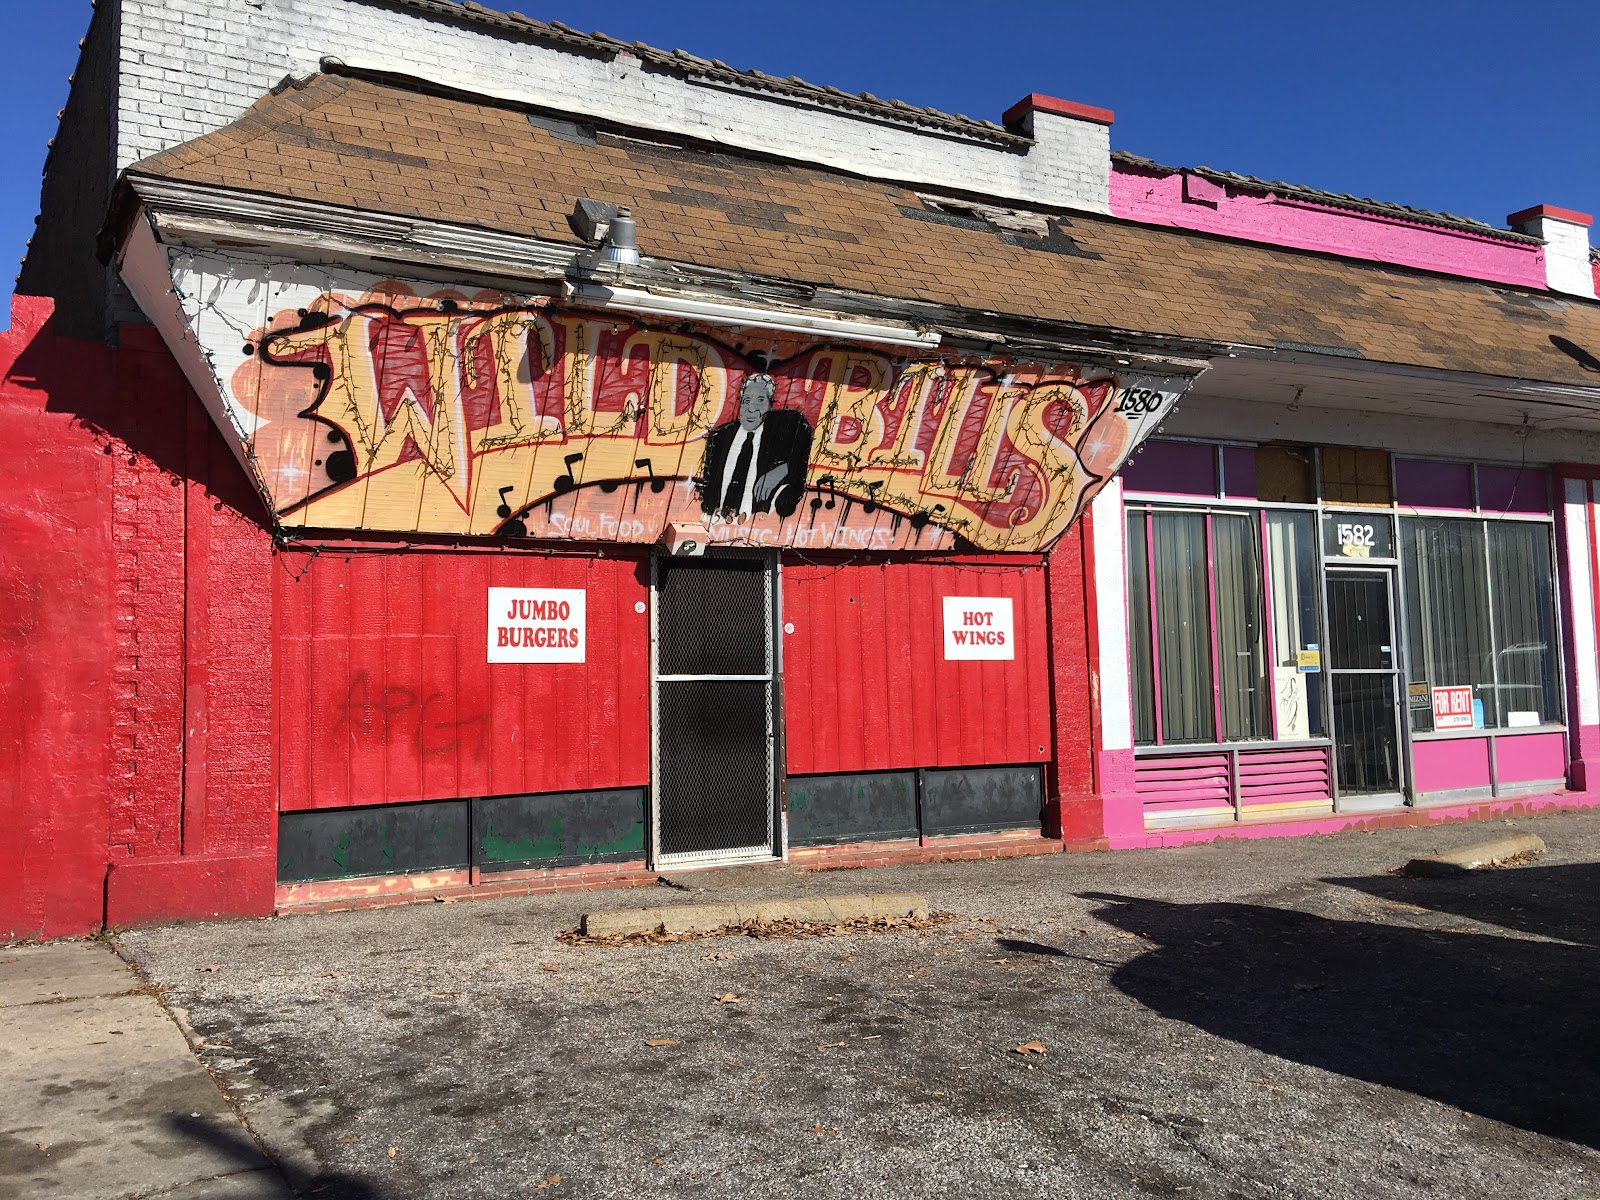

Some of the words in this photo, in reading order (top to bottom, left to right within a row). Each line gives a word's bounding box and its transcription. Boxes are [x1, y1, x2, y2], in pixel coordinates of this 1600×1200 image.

[1113, 387, 1163, 412] 1580
[262, 304, 728, 516] WILD
[804, 348, 1096, 552] BILLS
[548, 511, 597, 536] SOUL
[599, 513, 644, 538] FOOD
[785, 523, 817, 546] HOT
[821, 522, 891, 549] WINGS
[1337, 523, 1375, 546] 1582
[507, 599, 570, 621] JUMBO
[962, 611, 994, 626] HOT
[497, 627, 579, 648] BURGERS
[952, 630, 1005, 646] WINGS
[1434, 691, 1450, 714] FOR
[1450, 690, 1470, 713] RENT
